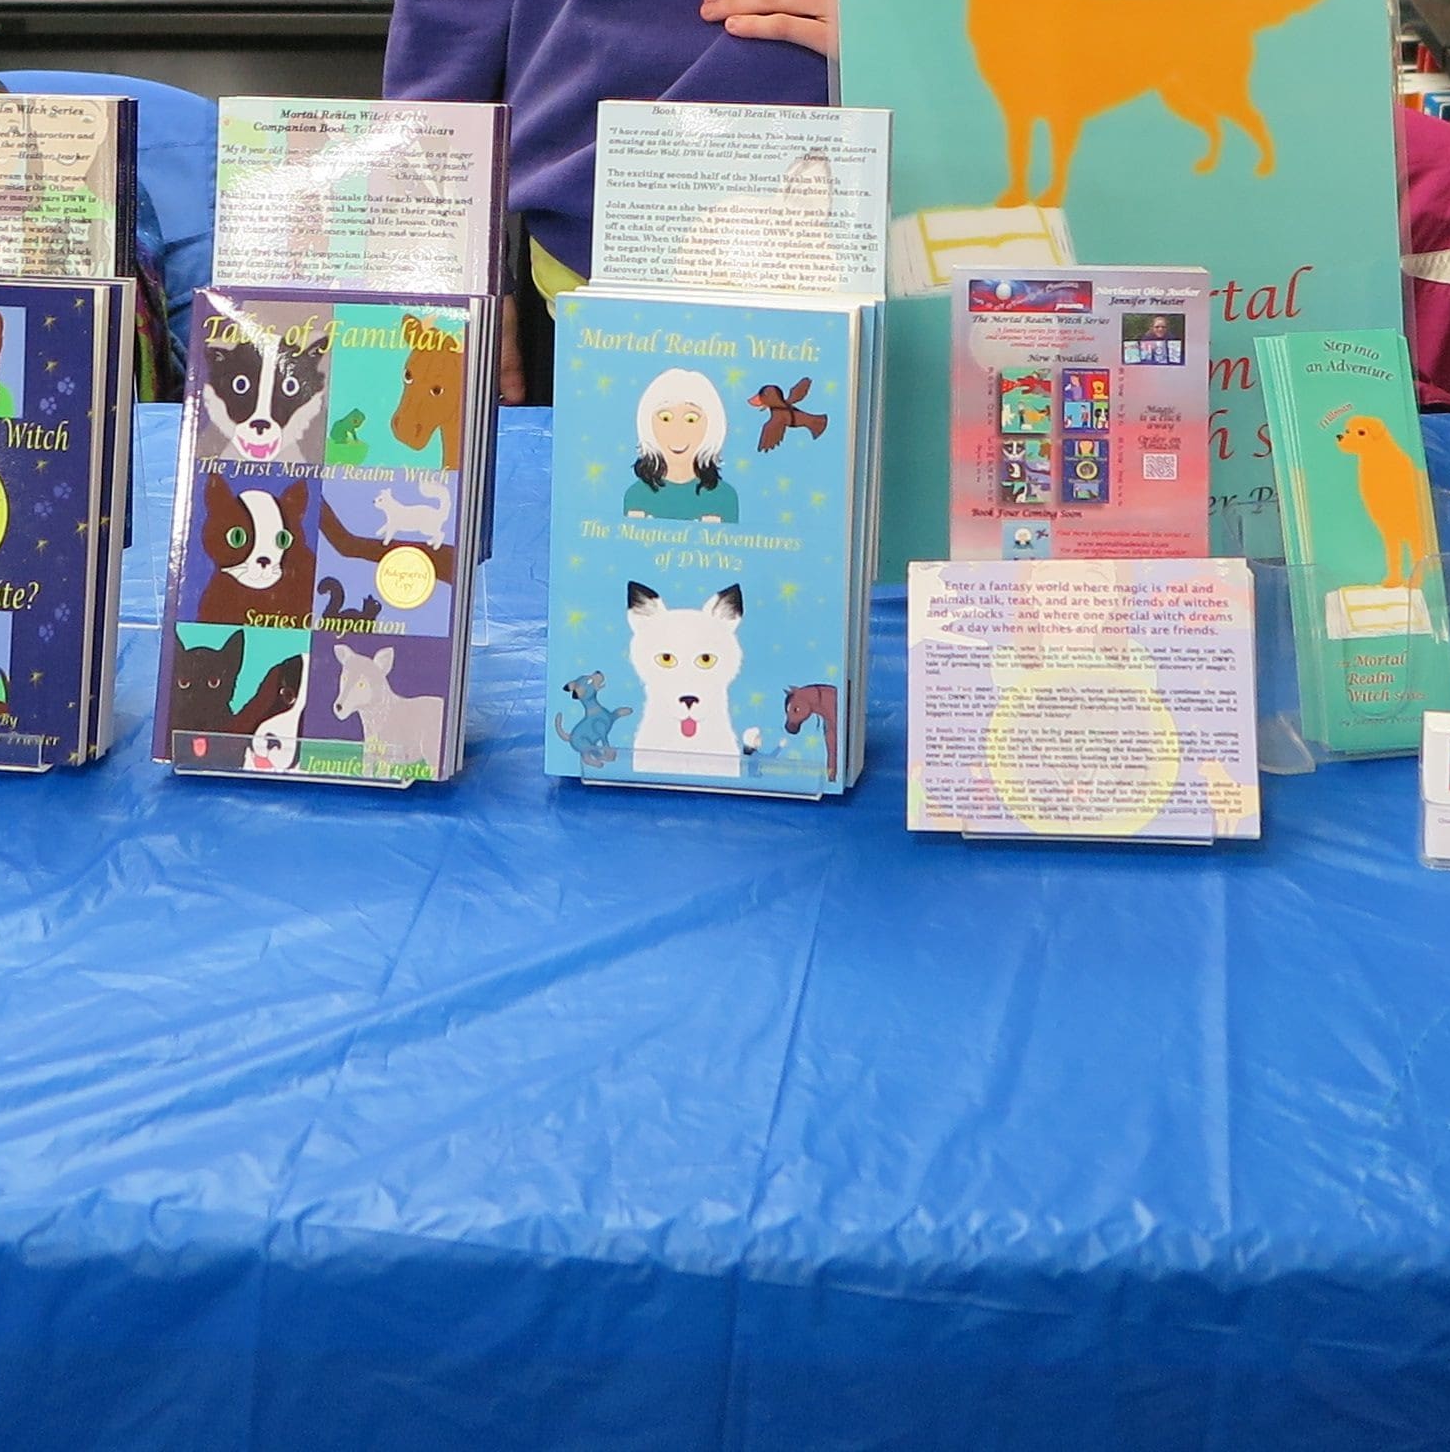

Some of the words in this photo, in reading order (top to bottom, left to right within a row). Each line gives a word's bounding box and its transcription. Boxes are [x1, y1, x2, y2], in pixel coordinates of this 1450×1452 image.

[1109, 296, 1146, 307] Jennifer
[1150, 297, 1186, 306] Priester
[284, 315, 316, 356] of
[318, 315, 465, 354] Familiars
[577, 327, 659, 353] Mortal
[664, 332, 739, 358] Realm
[746, 334, 822, 364] Witch:
[1027, 354, 1049, 363] Now
[1053, 354, 1100, 363] Available
[1323, 340, 1352, 354] Step
[1354, 345, 1380, 360] into
[1305, 363, 1323, 373] an
[1326, 359, 1394, 380] Adventure
[2, 417, 70, 452] Witch
[196, 456, 228, 476] The
[230, 456, 274, 480] First
[275, 460, 341, 481] Mortal
[342, 462, 396, 482] Realm
[399, 464, 451, 485] Witch
[580, 519, 613, 541] The
[616, 523, 690, 546] Magical
[698, 528, 804, 552] Adventures
[654, 548, 673, 568] of
[944, 580, 975, 592] Enter
[979, 584, 986, 592] a
[989, 581, 1033, 596] fantasy
[1036, 581, 1070, 593] world
[1072, 582, 1109, 593] where
[1113, 583, 1148, 596] magic
[1151, 583, 1162, 593] is
[1166, 583, 1188, 594] real
[1191, 583, 1214, 594] and
[244, 608, 299, 631] Series
[300, 612, 408, 637] Companion
[1355, 649, 1409, 666] Mortal
[1348, 672, 1395, 685] Realm
[1348, 688, 1390, 702] Witch
[302, 752, 375, 777] Jennifer
[377, 754, 438, 781] Priester
